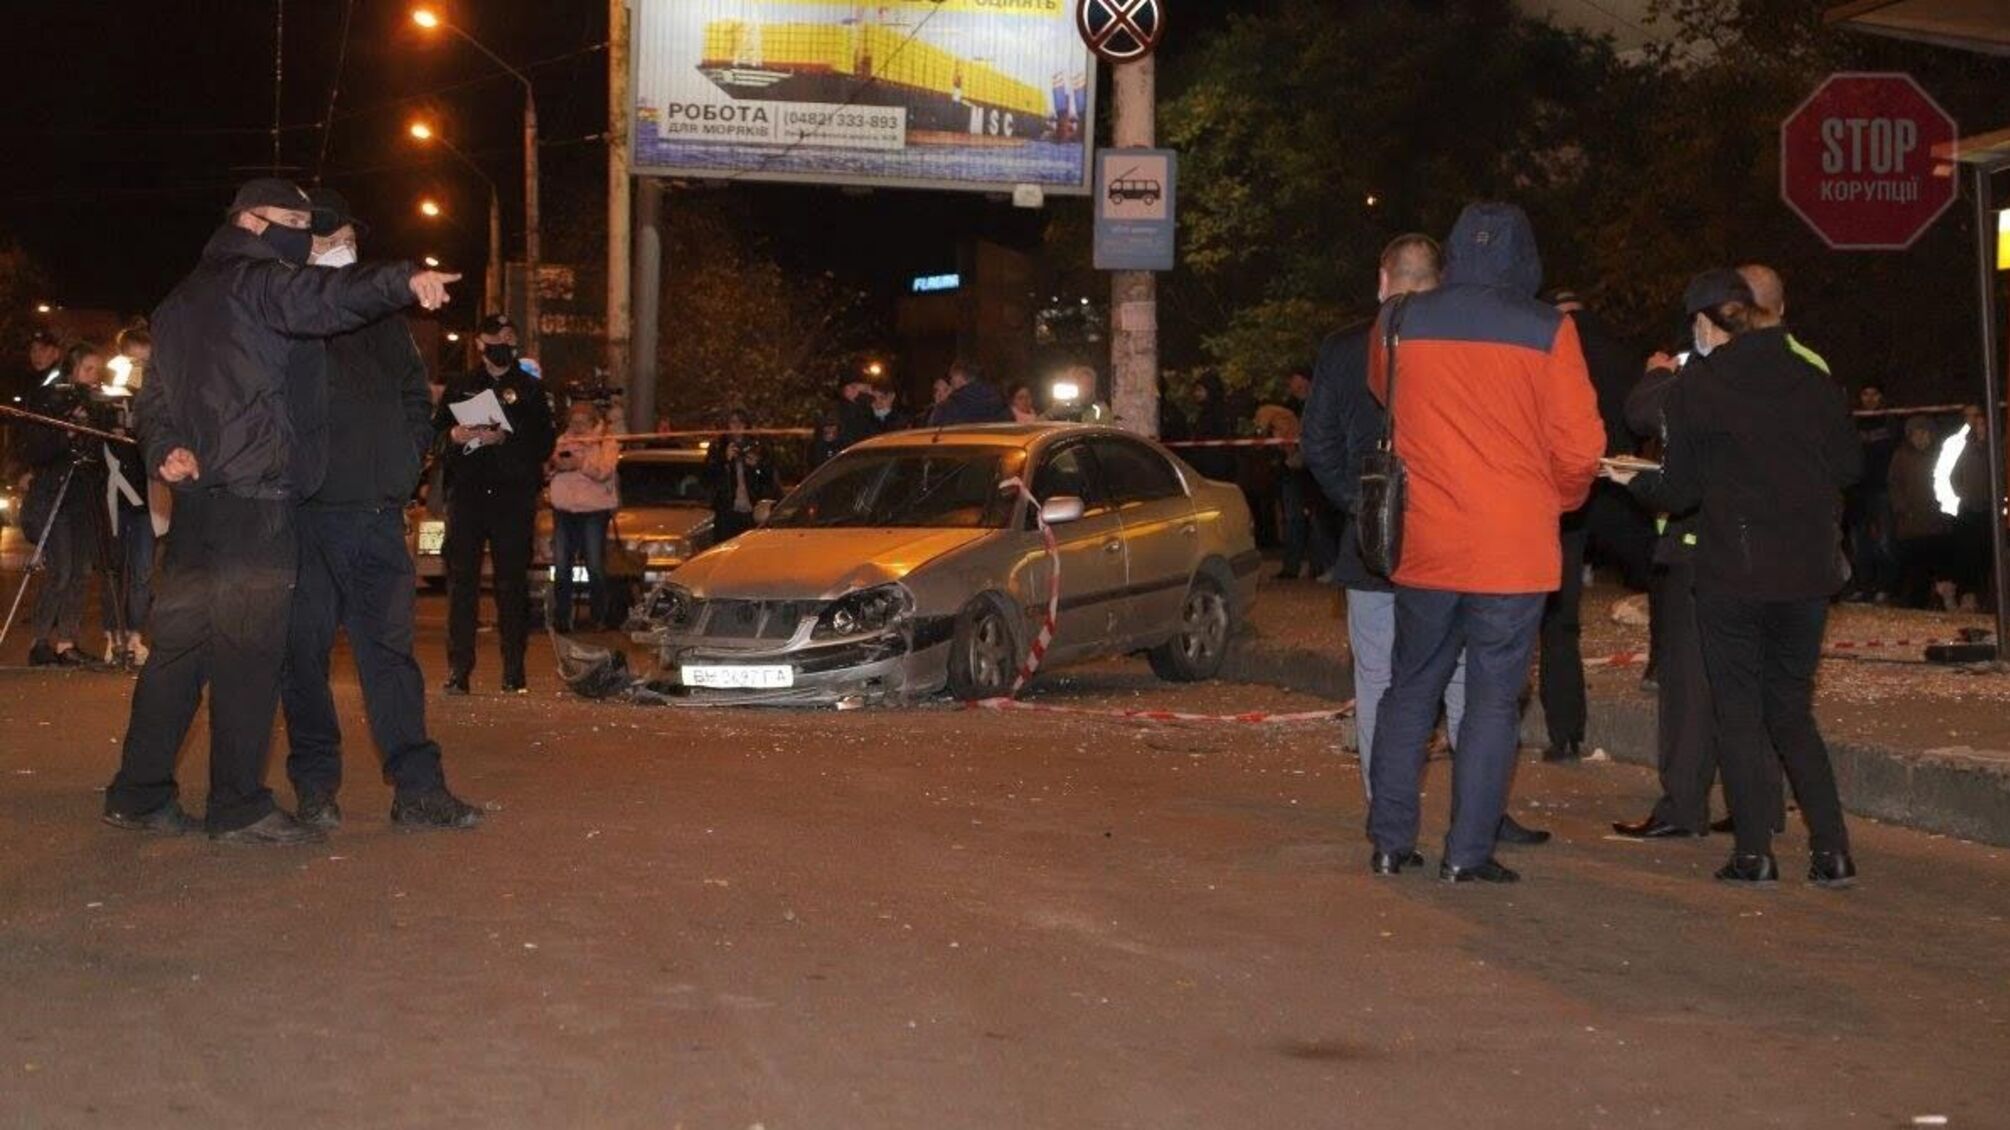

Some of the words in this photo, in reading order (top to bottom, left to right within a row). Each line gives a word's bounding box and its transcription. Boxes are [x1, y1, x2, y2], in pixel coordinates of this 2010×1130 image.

[668, 103, 768, 123] РОБОТА
[970, 105, 1013, 137] MSC
[668, 123, 697, 134] ДЛЯ
[702, 124, 768, 137] МОРЯКІВ
